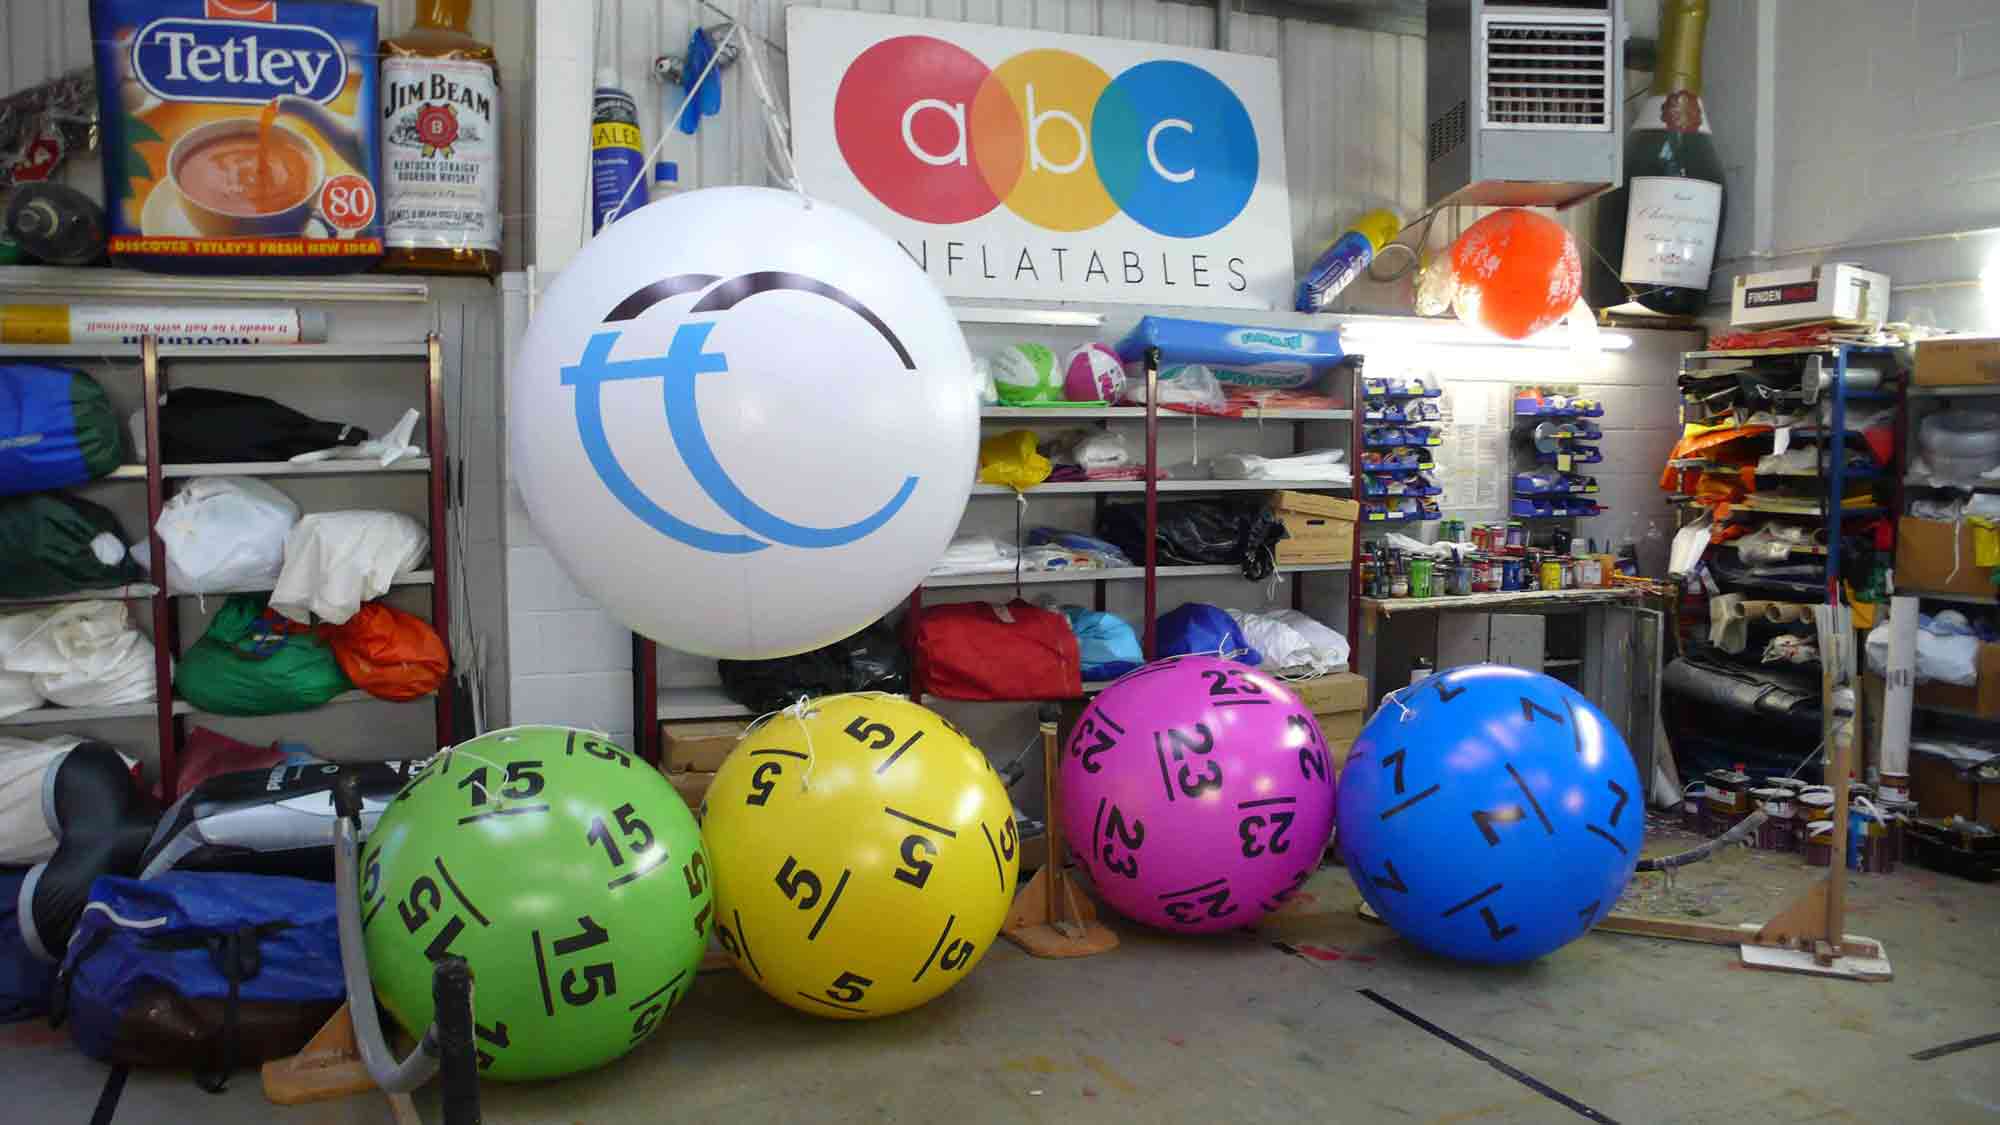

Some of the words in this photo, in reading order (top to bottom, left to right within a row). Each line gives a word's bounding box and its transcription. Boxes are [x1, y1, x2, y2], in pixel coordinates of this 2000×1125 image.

[155, 31, 331, 95] Tetley
[384, 82, 424, 119] JIM
[429, 73, 491, 122] BEAM
[393, 159, 436, 171] KENTUCKY
[438, 160, 480, 174] STRAIGHT
[398, 172, 437, 182] BOURBON
[439, 172, 477, 184] WHISKEY
[329, 186, 370, 217] 80
[115, 239, 188, 253] DISCOVER
[259, 241, 304, 255] FRESH
[308, 241, 339, 255] NEW
[343, 241, 377, 255] IDEA
[897, 240, 1247, 292] NFLATABLES
[1748, 288, 1782, 307] FINDEN
[153, 323, 181, 334] with
[1201, 670, 1263, 695] 23
[844, 716, 895, 750] 5
[1520, 697, 1565, 725] 7
[1072, 719, 1118, 774] 23
[1167, 723, 1223, 798] 23
[457, 760, 546, 807] 15
[746, 761, 782, 807] 5
[1382, 748, 1406, 795] 7
[1472, 804, 1527, 847] 7
[1608, 780, 1630, 827] 7
[587, 803, 656, 867] 15
[999, 816, 1018, 862] 5
[1103, 804, 1145, 879] 23
[1238, 811, 1296, 858] 23
[774, 855, 823, 909] 5
[894, 834, 939, 889] 5
[1165, 888, 1239, 923] 23
[1480, 905, 1519, 942] 7
[551, 915, 617, 1007] 15
[939, 937, 975, 970] 5
[825, 971, 873, 1003] 5
